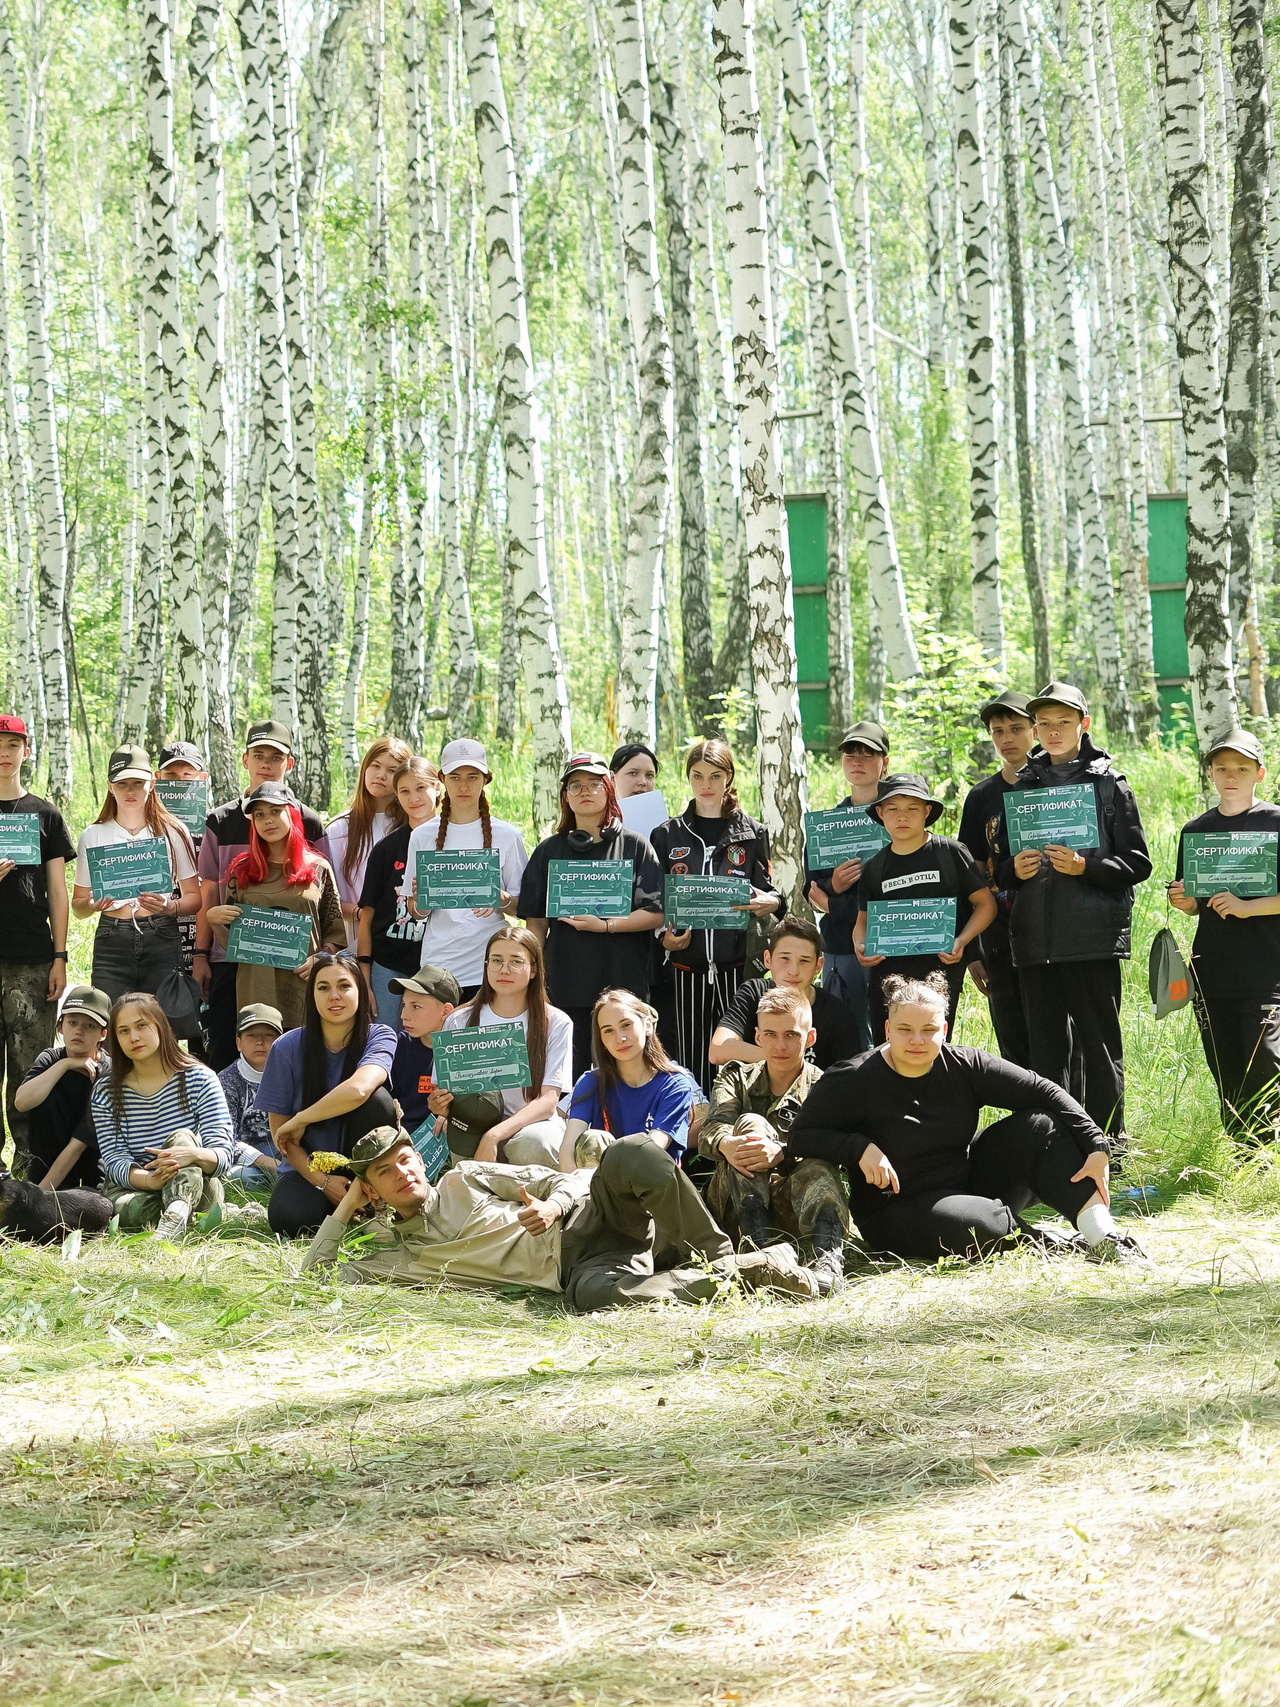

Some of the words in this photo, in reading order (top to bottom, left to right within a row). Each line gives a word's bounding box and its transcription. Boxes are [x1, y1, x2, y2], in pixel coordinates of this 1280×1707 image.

[156, 792, 198, 800] ТИФИКАТ
[1017, 799, 1083, 814] СЕРТИФИКАТ
[816, 816, 878, 832] СЕРТИФИКА
[1196, 846, 1265, 856] СЕРТИФИКАТ
[98, 851, 158, 867] СЕРТИФИКАТ
[427, 862, 489, 872] СЕРТИФИКАТ
[560, 873, 622, 882] СЕРТИФИКАТ
[914, 873, 938, 882] ОТЦА
[676, 885, 739, 895] СЕРТИФИКАТ
[879, 911, 945, 922] СЕРТИФИКАТ
[241, 917, 301, 934] СЕРТИФИКАТ
[445, 1037, 513, 1054] СЕРТИФИКАТ
